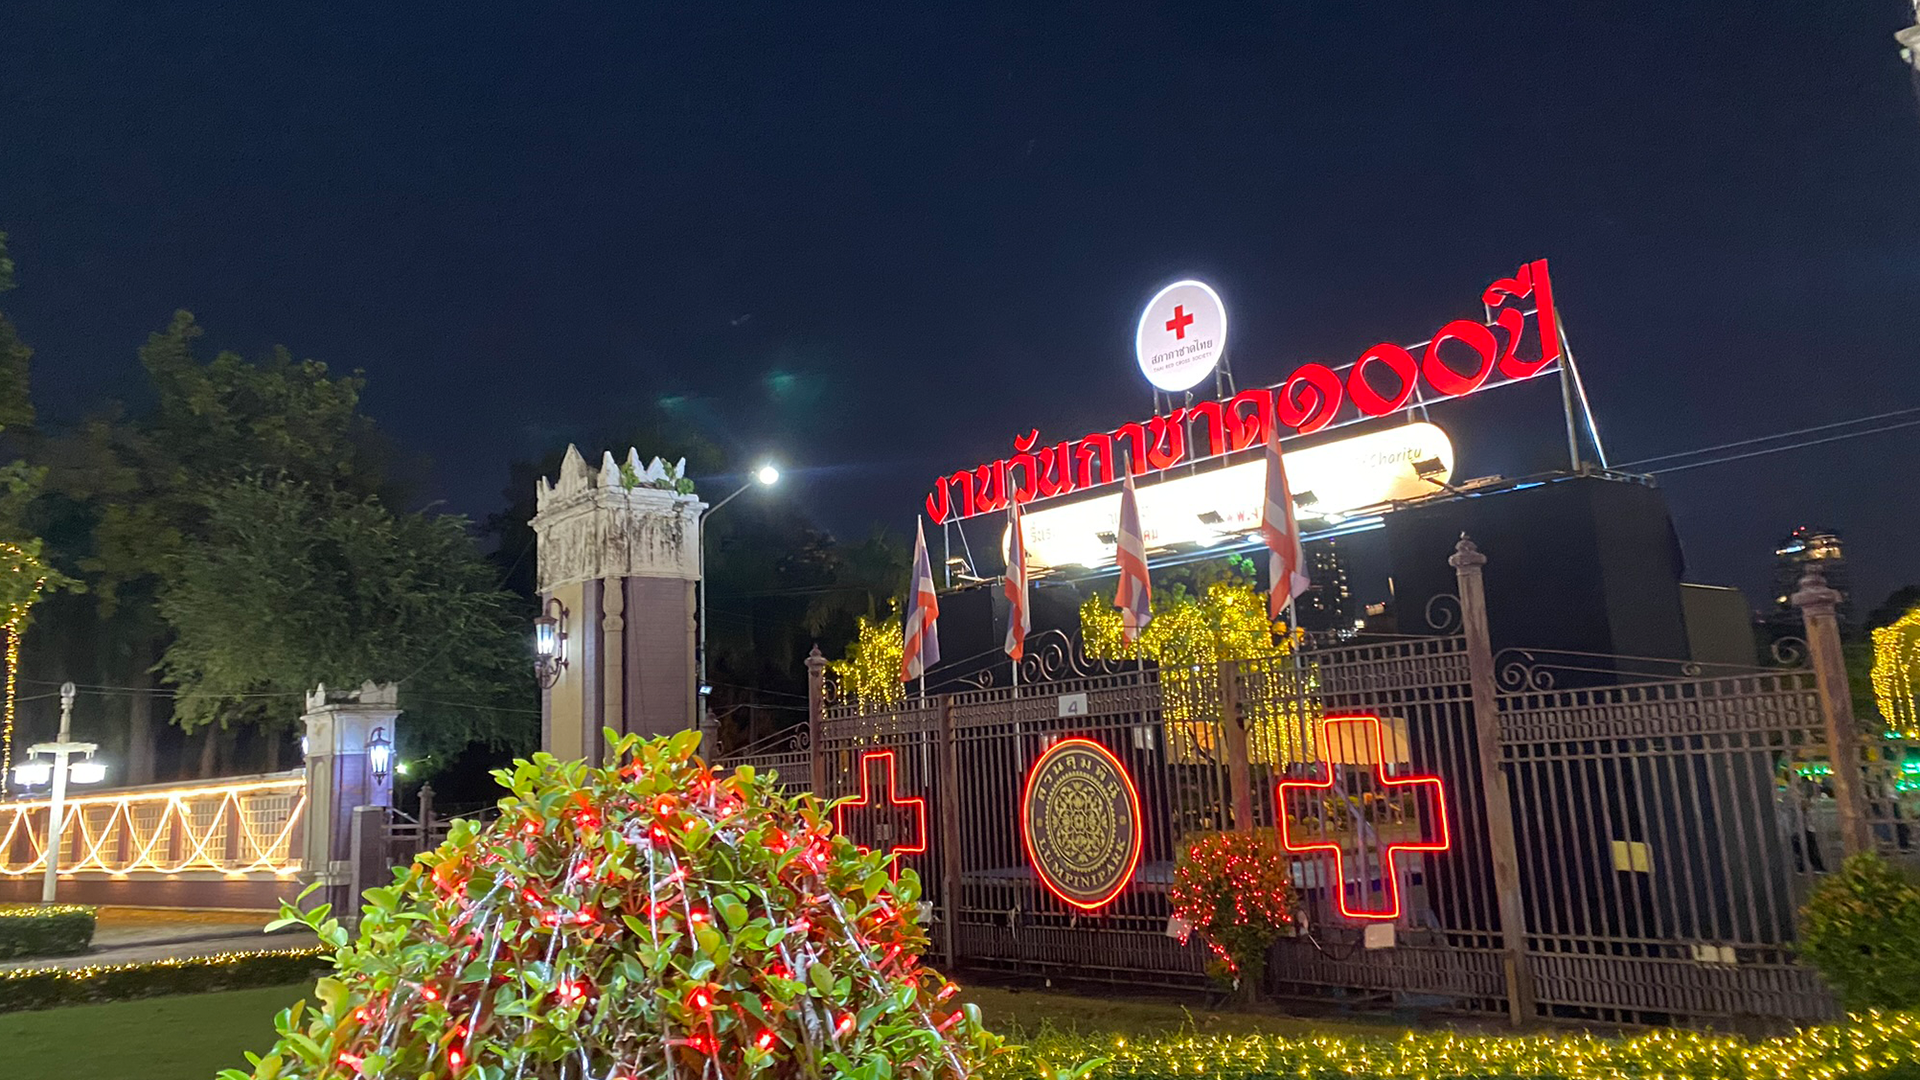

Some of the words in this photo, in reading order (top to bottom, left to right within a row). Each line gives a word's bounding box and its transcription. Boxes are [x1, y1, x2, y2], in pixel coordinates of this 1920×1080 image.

[1151, 339, 1213, 365] สภากาชาดไทย
[1176, 358, 1191, 367] CROSS
[1192, 352, 1212, 362] SOCIETY
[1068, 701, 1078, 714] 4
[1038, 756, 1120, 801] สวนลุมพินี
